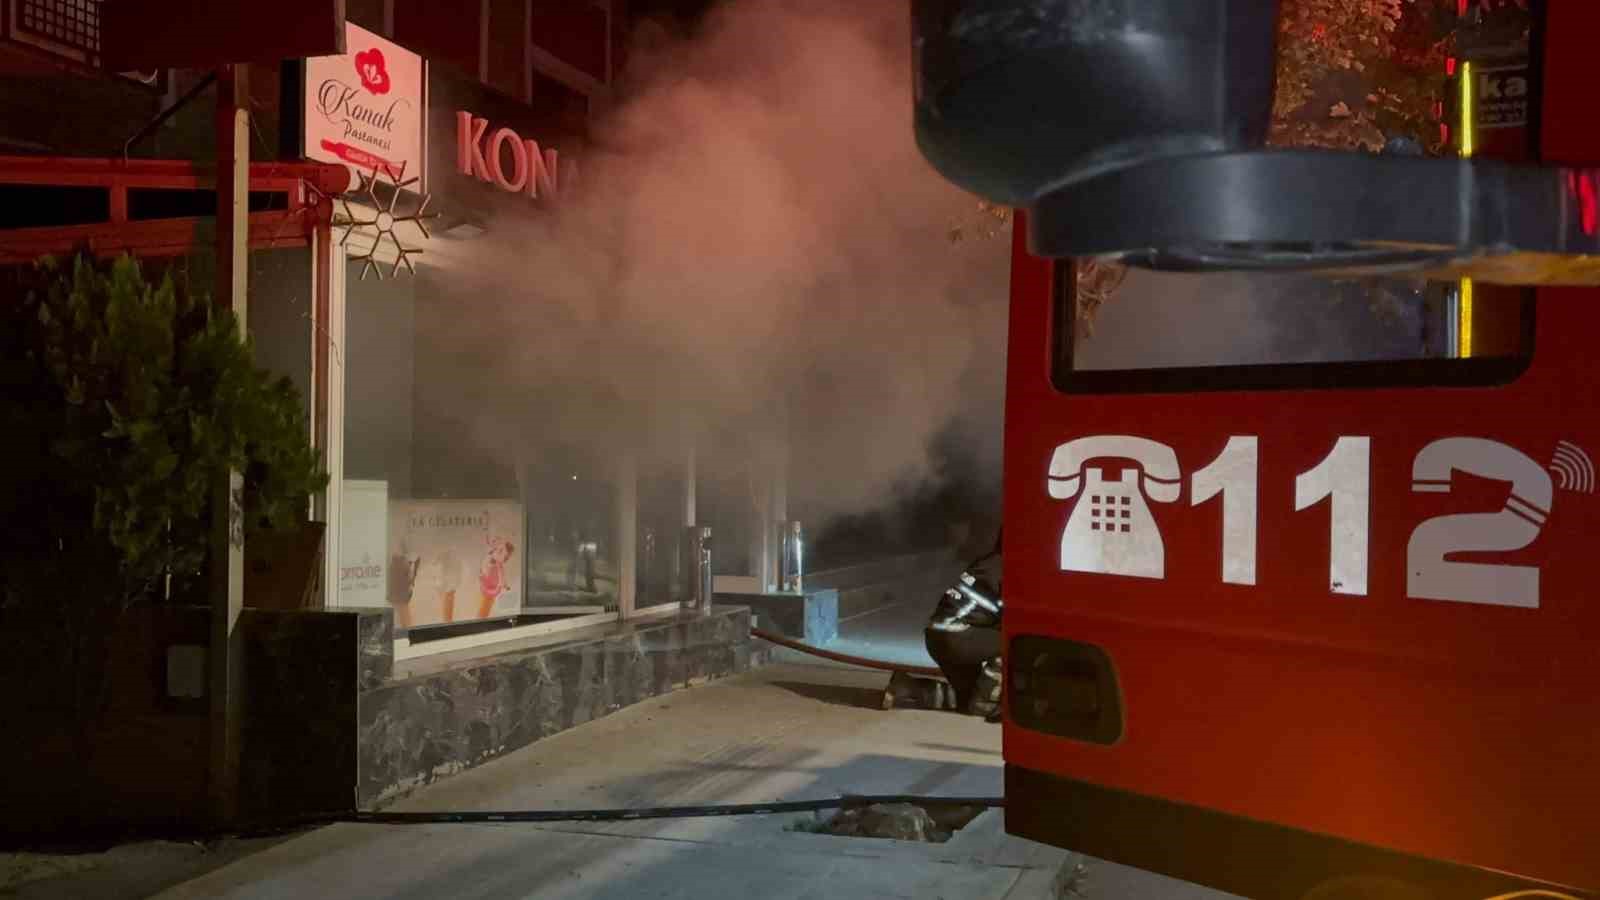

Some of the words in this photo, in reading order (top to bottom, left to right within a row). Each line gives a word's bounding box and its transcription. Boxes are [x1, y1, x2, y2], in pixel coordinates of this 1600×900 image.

[317, 79, 411, 133] Konak
[341, 119, 392, 152] Pastanesi
[1191, 435, 1553, 609] 112
